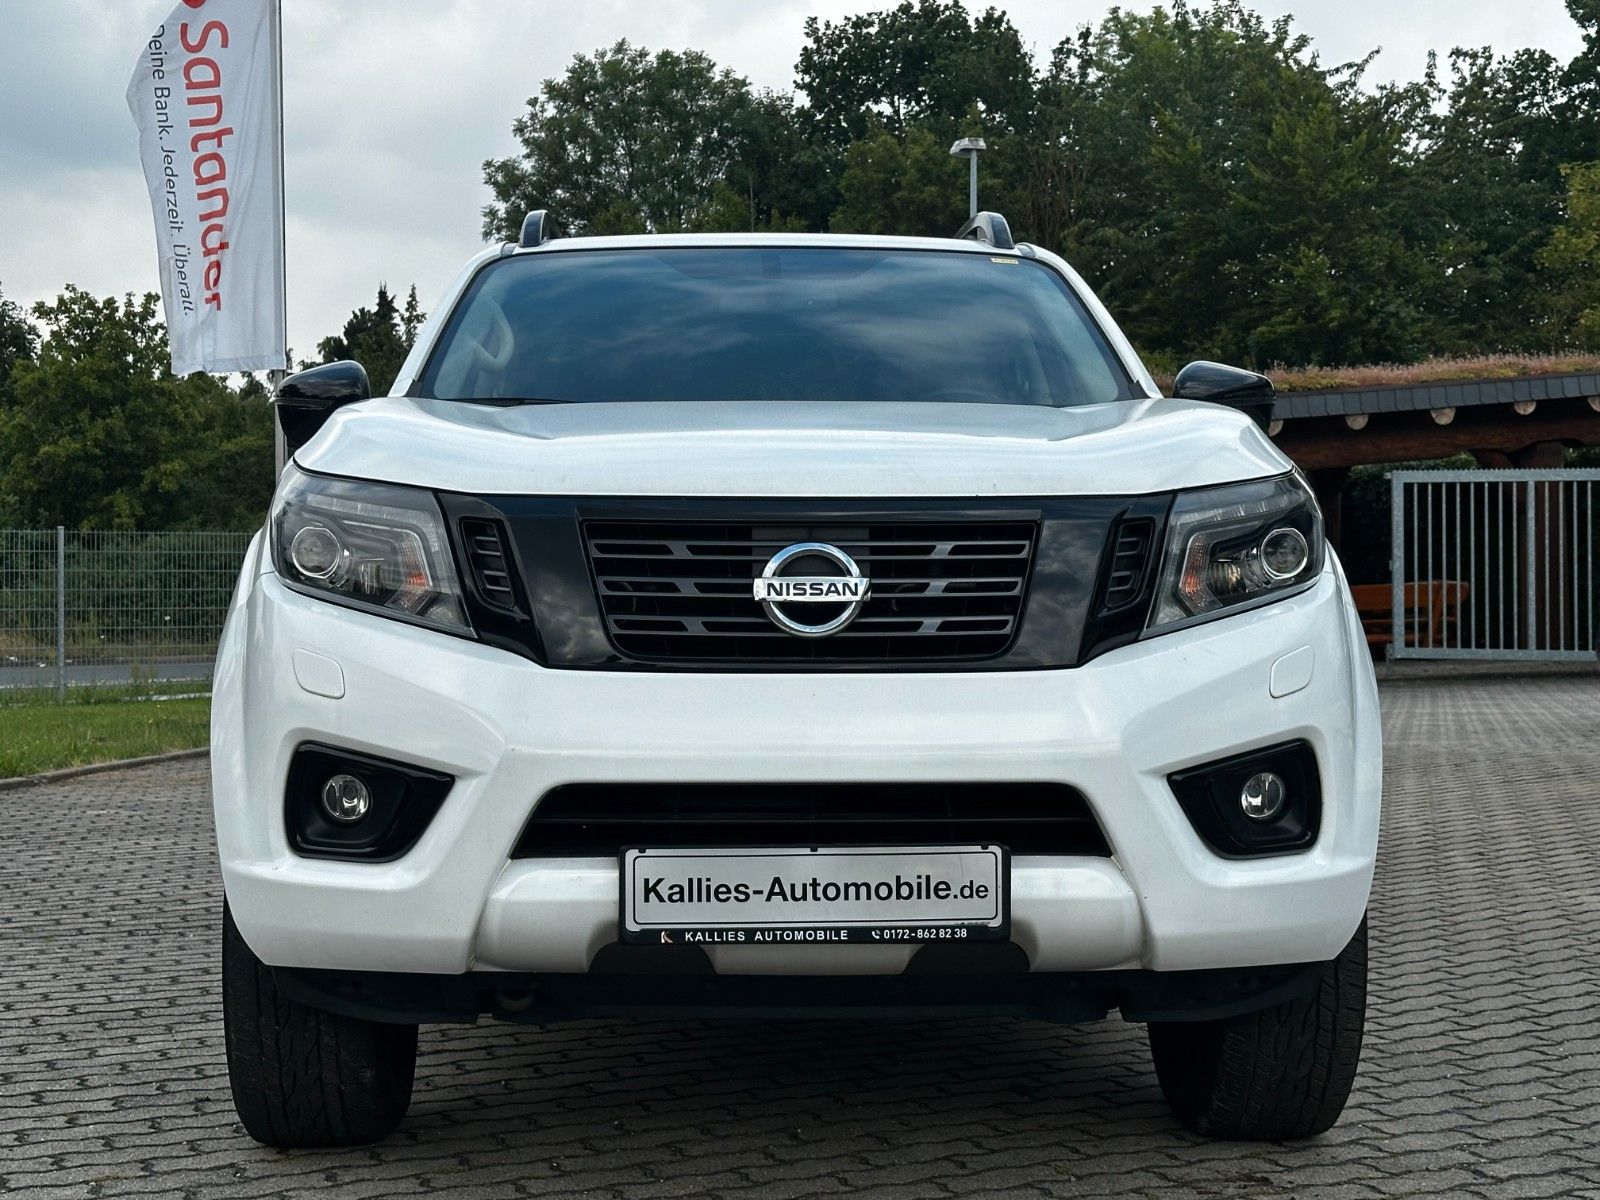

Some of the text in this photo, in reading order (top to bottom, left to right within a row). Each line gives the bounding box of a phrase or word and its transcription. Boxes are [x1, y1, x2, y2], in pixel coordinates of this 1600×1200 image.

[180, 20, 234, 312] Santander
[153, 87, 174, 140] Bank.
[173, 244, 194, 315] Überall.
[766, 582, 859, 597] NISSAN
[643, 874, 989, 903] Kallies-Automobile.de
[685, 931, 745, 942] KALLIES
[754, 930, 849, 942] AUTOMOBILE
